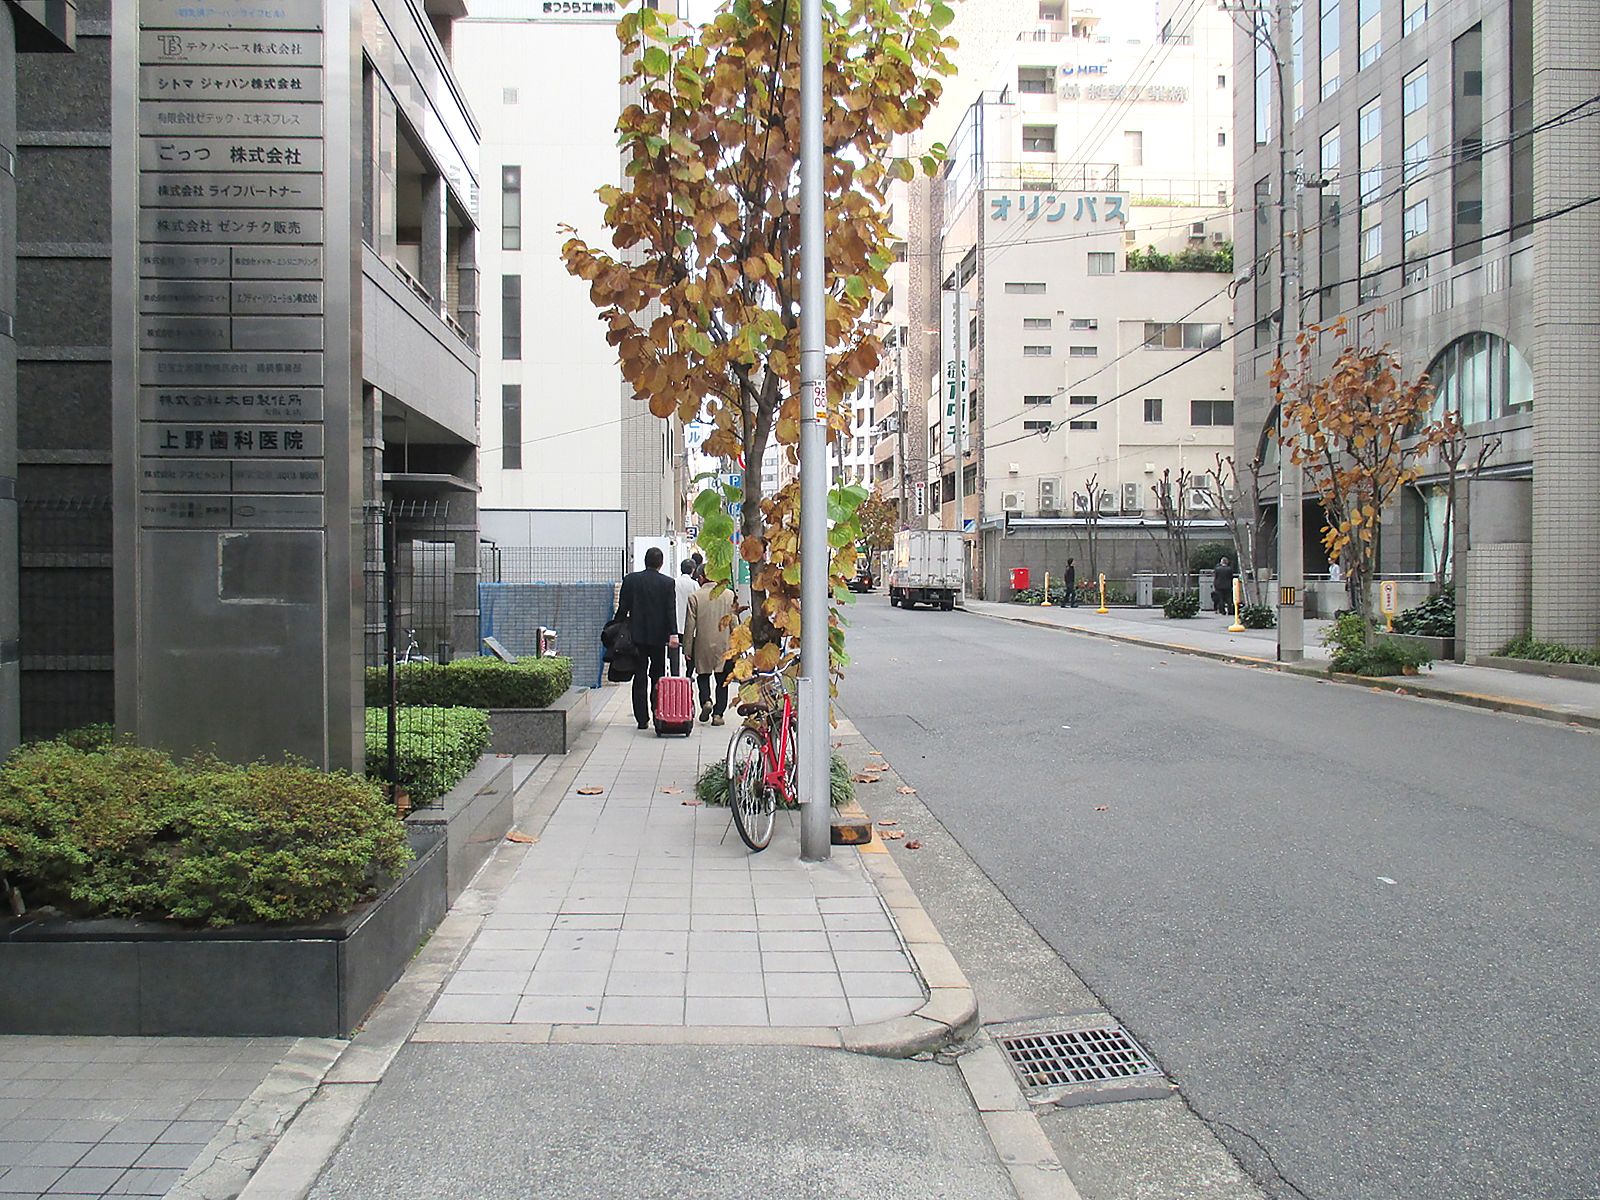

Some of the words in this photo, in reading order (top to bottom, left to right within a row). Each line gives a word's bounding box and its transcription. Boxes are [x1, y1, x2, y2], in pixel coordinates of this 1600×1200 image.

[187, 43, 303, 55] テクノベース株式会社
[200, 78, 302, 89] ジャパン株式会社
[160, 145, 211, 161] ごっつ
[230, 147, 302, 165] 株式会社
[158, 185, 204, 196] 株式会社
[210, 185, 302, 197] ライフパートナー
[991, 195, 1126, 223] オリンパス
[157, 220, 212, 233] 株式会社
[218, 221, 301, 235] ゼンチク販売
[159, 394, 220, 407] 株式会社
[160, 430, 304, 450] 上野歯科医院
